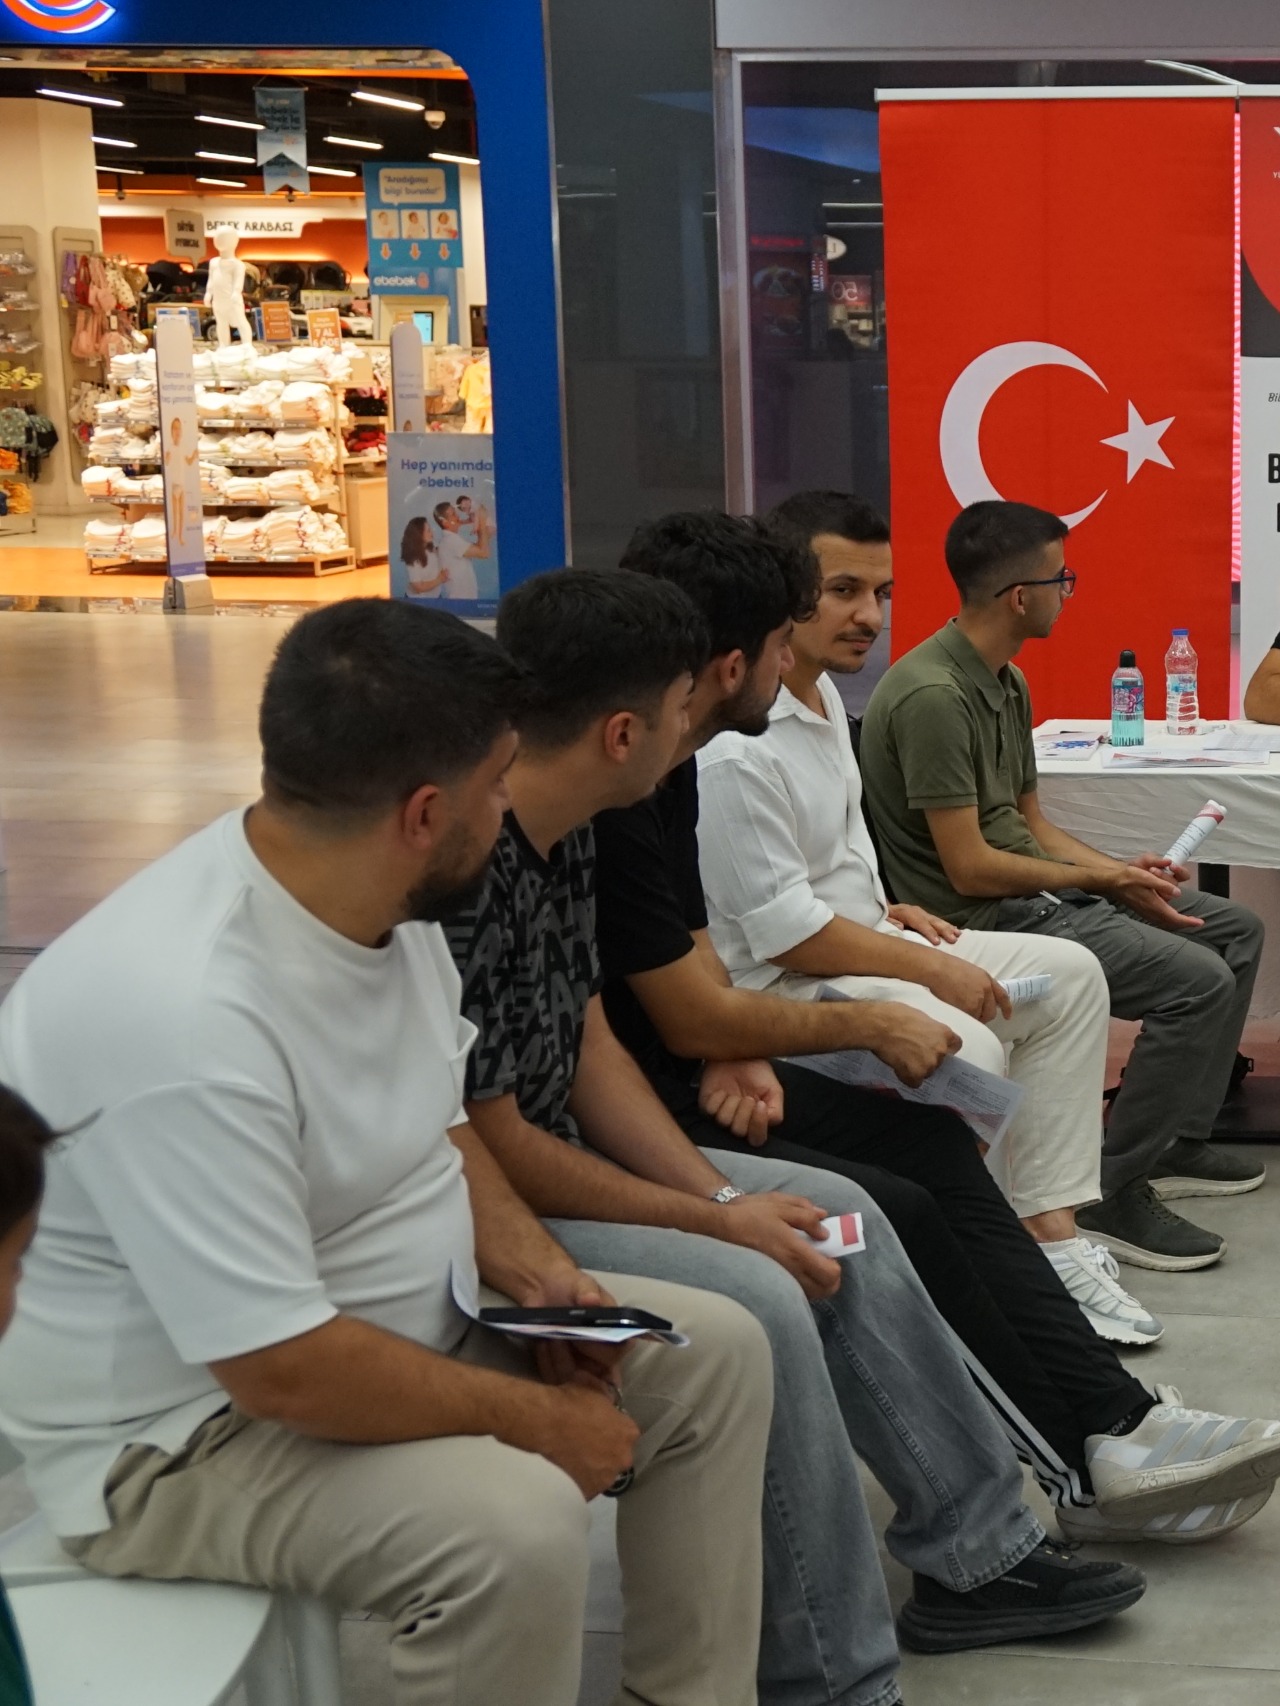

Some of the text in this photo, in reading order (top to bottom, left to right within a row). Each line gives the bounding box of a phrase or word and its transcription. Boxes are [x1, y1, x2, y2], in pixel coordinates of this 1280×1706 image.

[244, 221, 294, 232] ARABASI
[373, 275, 416, 287] ebebek
[400, 459, 493, 474] Hep yanımda
[419, 475, 474, 488] ebebek!
